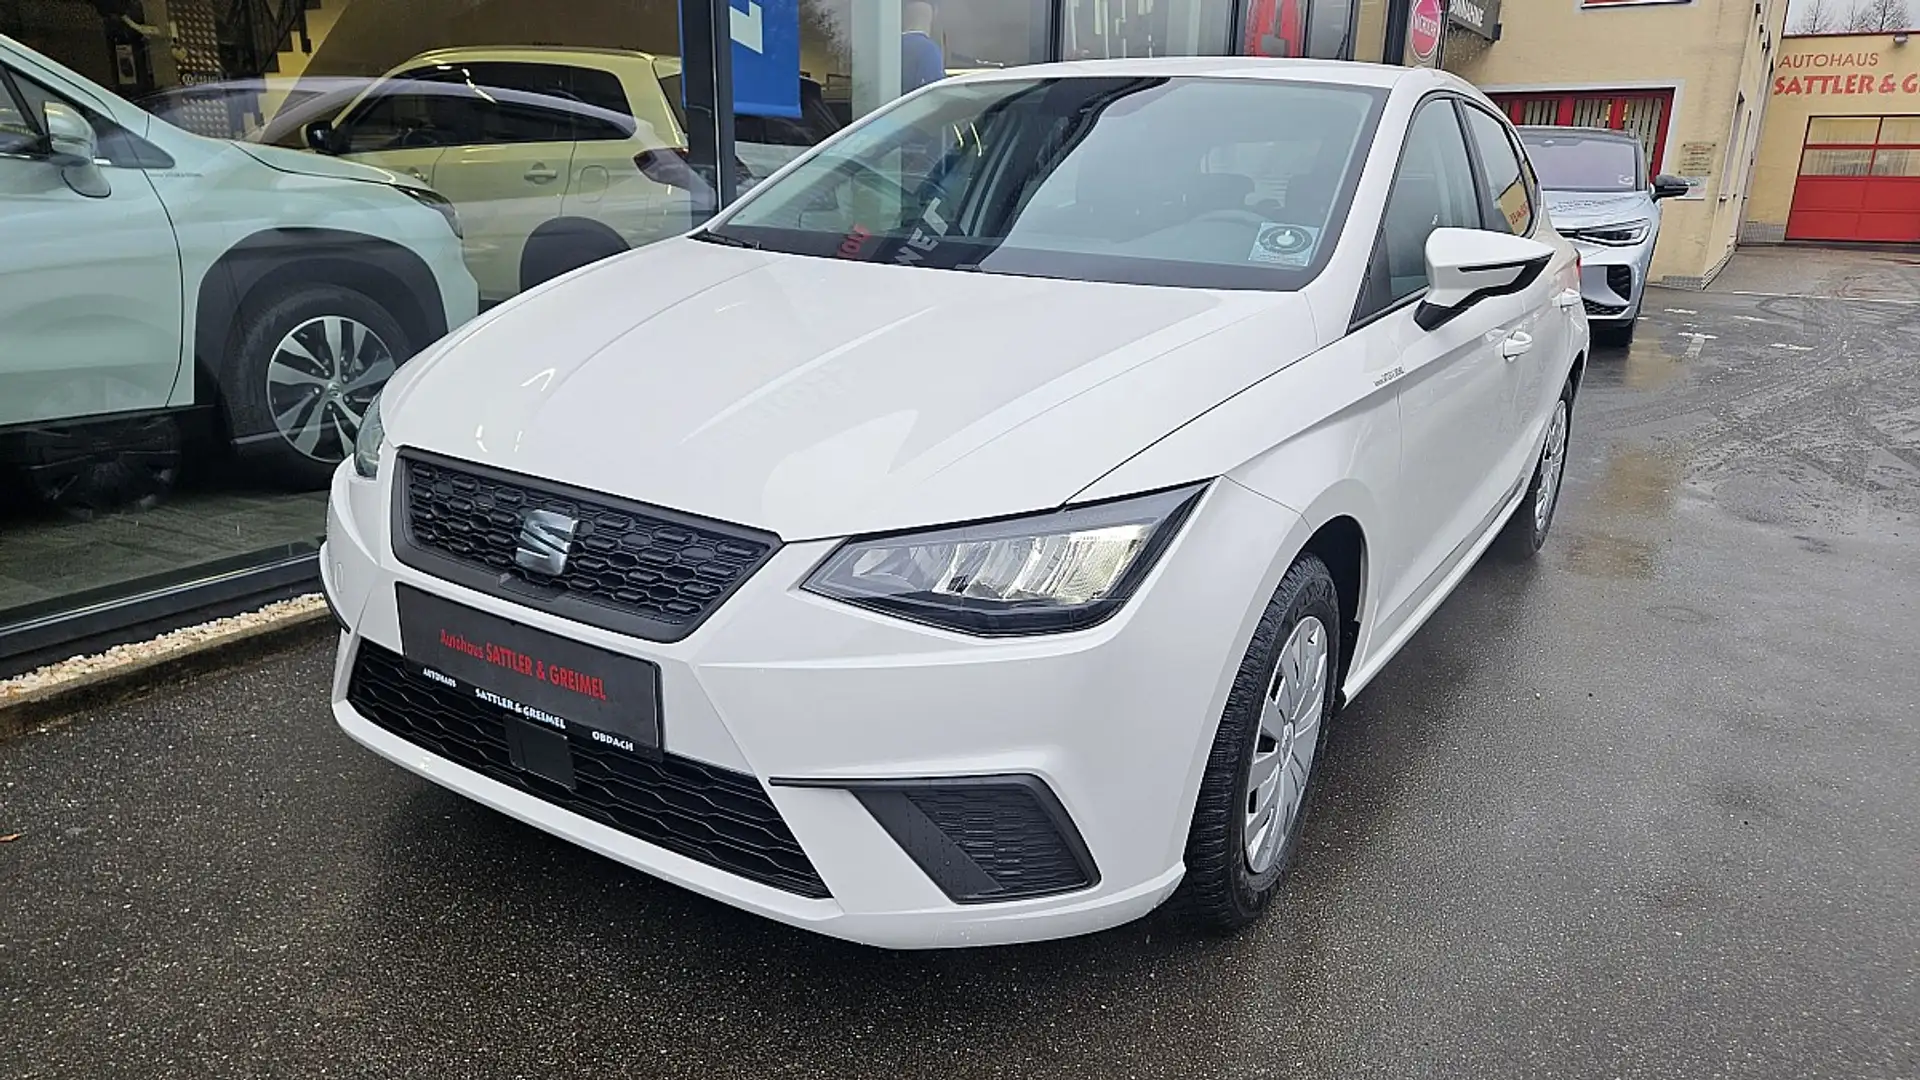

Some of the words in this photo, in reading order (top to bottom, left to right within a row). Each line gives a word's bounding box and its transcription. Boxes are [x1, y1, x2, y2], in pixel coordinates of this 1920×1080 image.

[1778, 53, 1879, 69] AUTOHAUS
[1773, 74, 1875, 95] SATTLER
[1878, 74, 1896, 94] &
[1902, 74, 1920, 94] G
[441, 629, 484, 659] Autohaus
[486, 642, 533, 676] SATTLER
[536, 660, 546, 680] &
[549, 664, 606, 701] GREIMEL
[475, 688, 514, 710] SATTLER
[514, 702, 523, 713] &
[523, 706, 566, 729] GREIMEL
[592, 731, 634, 751] OBDACH
